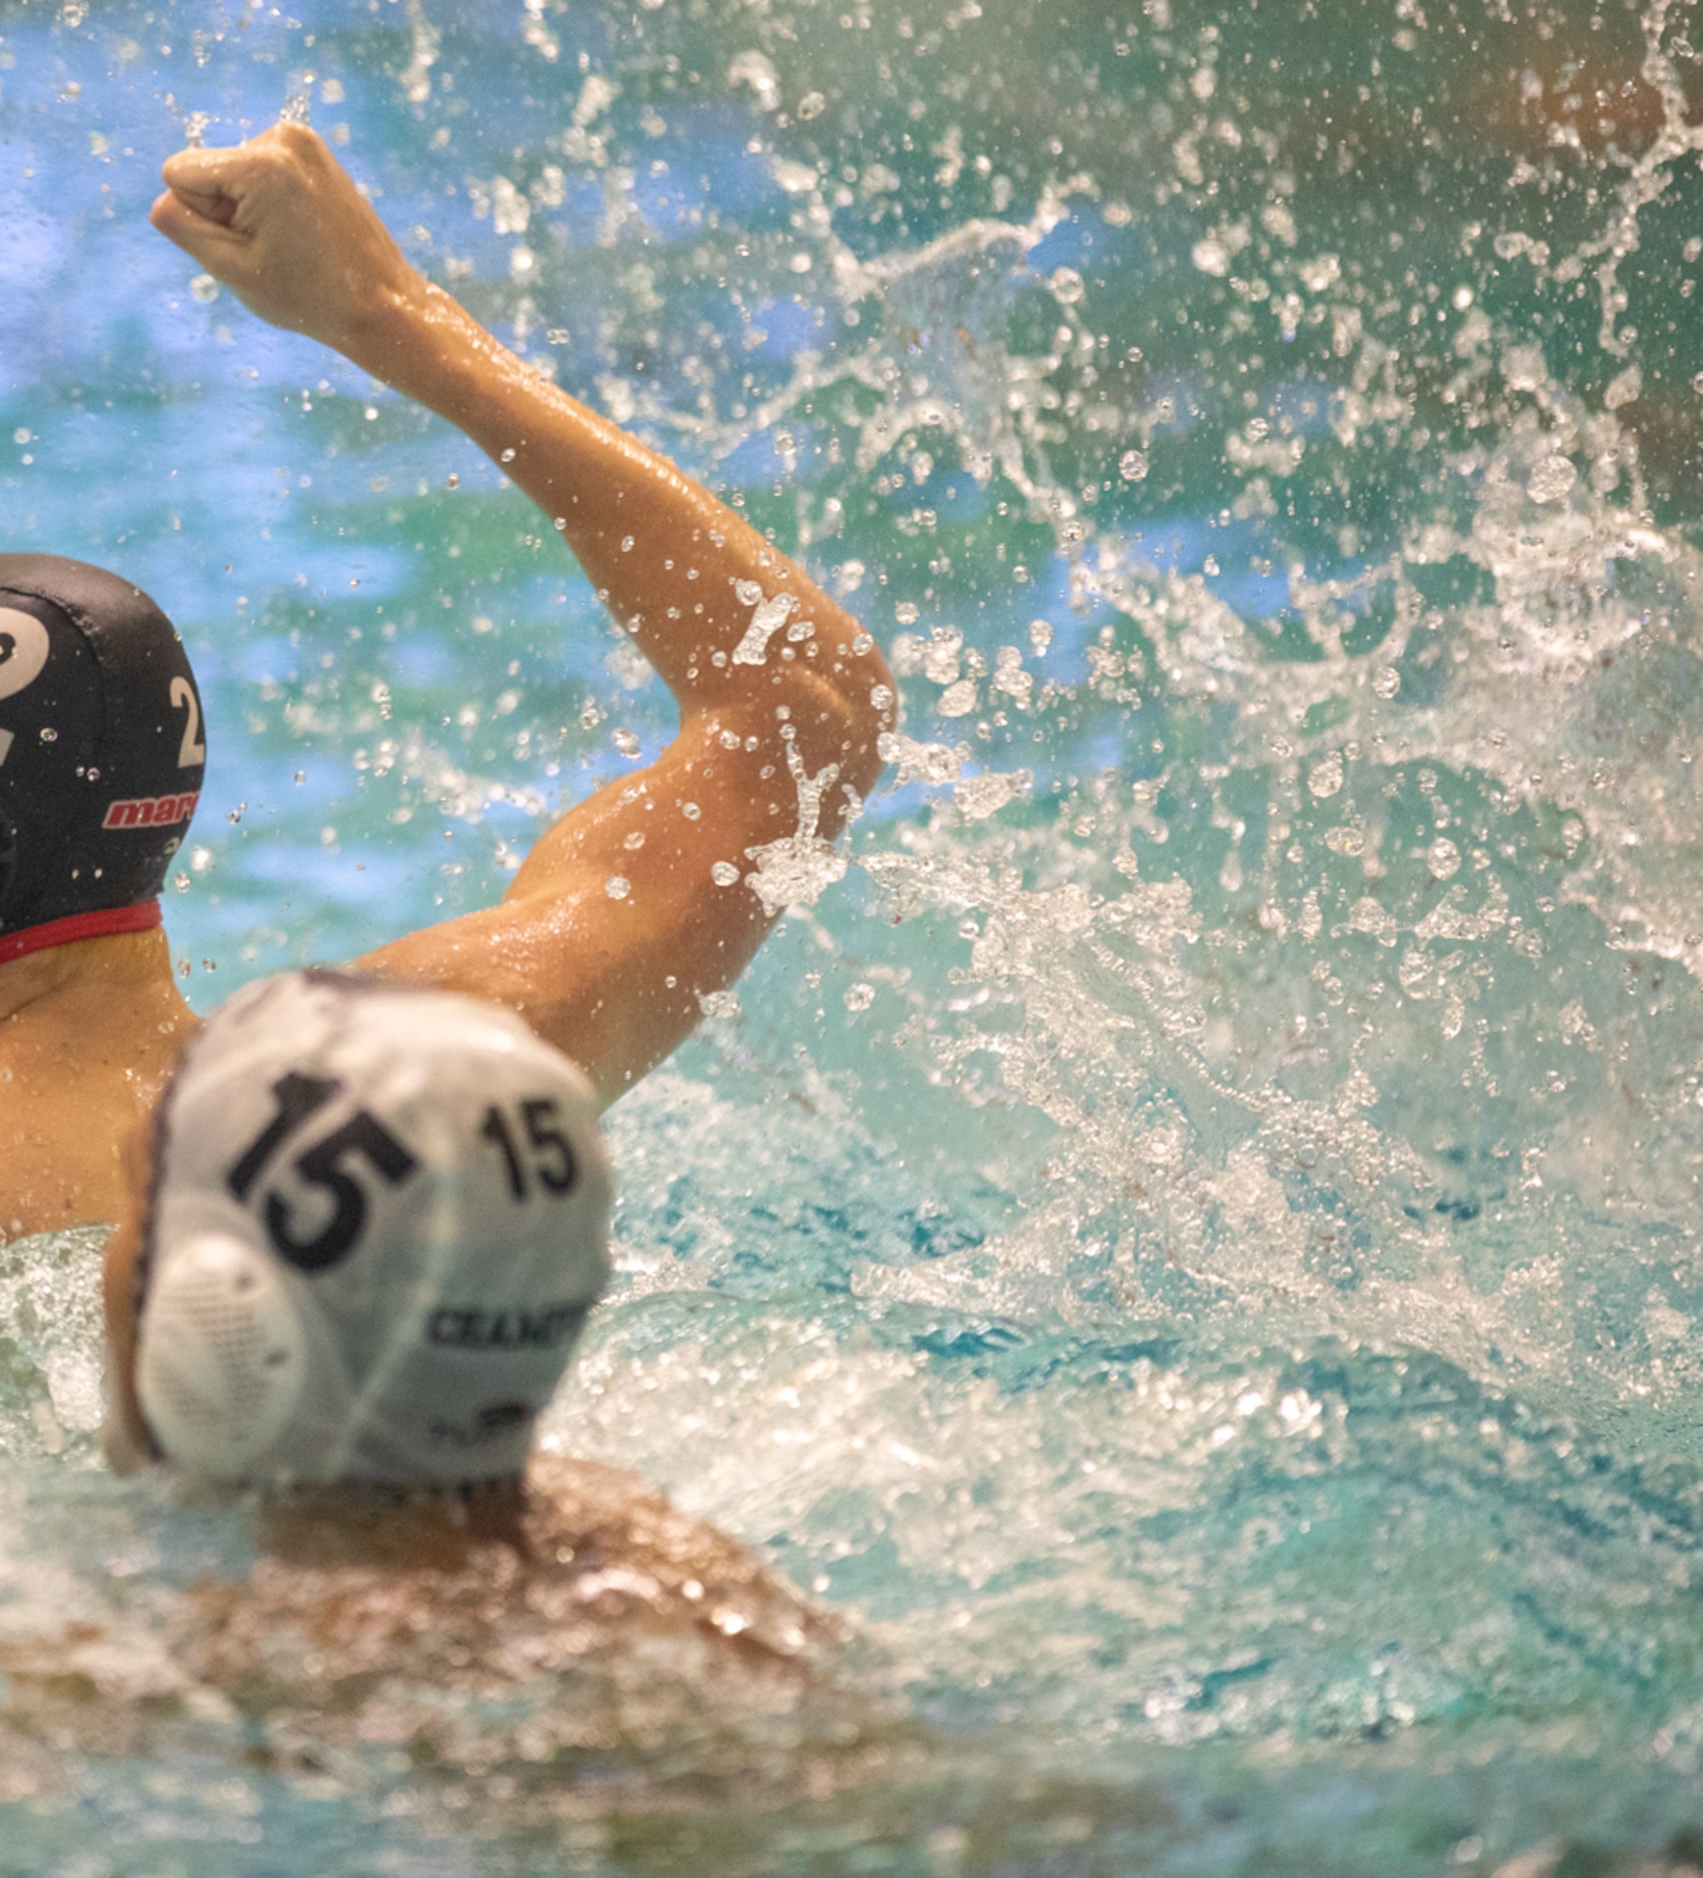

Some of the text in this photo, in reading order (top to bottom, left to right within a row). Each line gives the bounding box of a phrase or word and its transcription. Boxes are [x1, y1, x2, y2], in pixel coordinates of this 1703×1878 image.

[170, 676, 204, 768] 2
[227, 1071, 420, 1273] 15
[481, 1097, 579, 1202] 15
